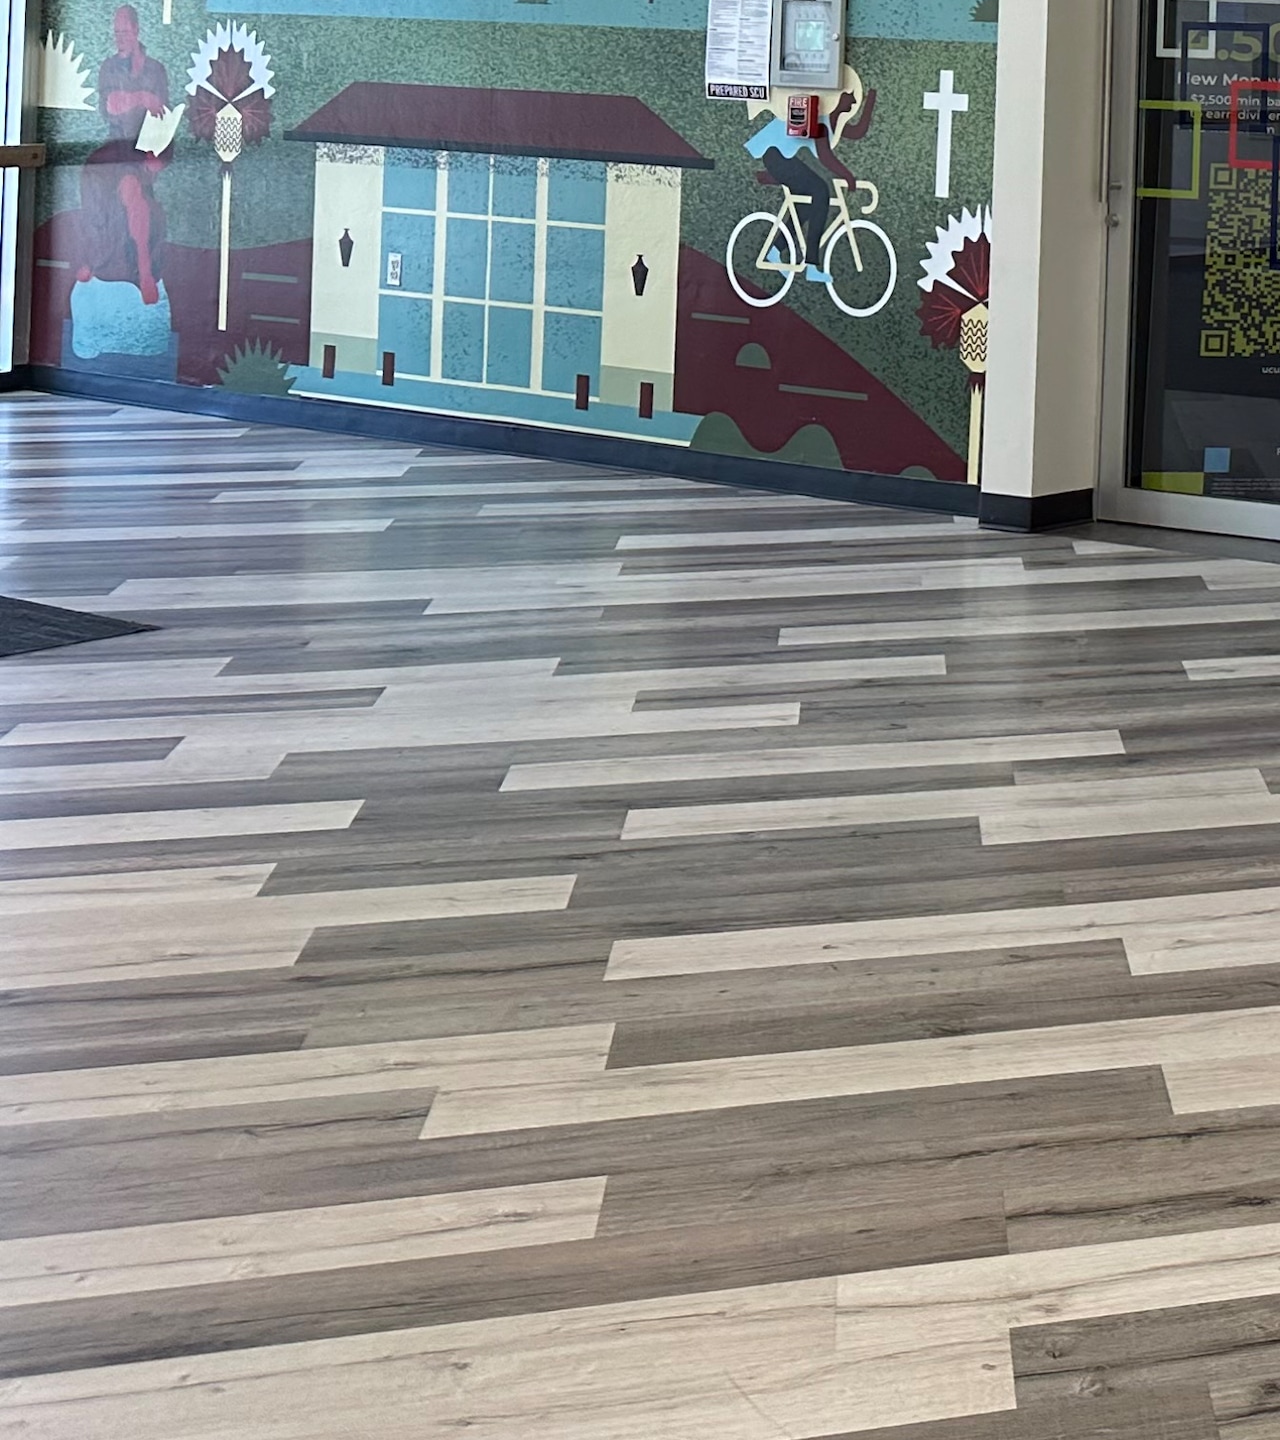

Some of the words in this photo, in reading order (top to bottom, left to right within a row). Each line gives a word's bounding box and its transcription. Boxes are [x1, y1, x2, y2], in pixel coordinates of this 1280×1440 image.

[709, 84, 748, 98] PREPARED
[749, 86, 765, 99] SCU
[789, 97, 808, 107] FIRE
